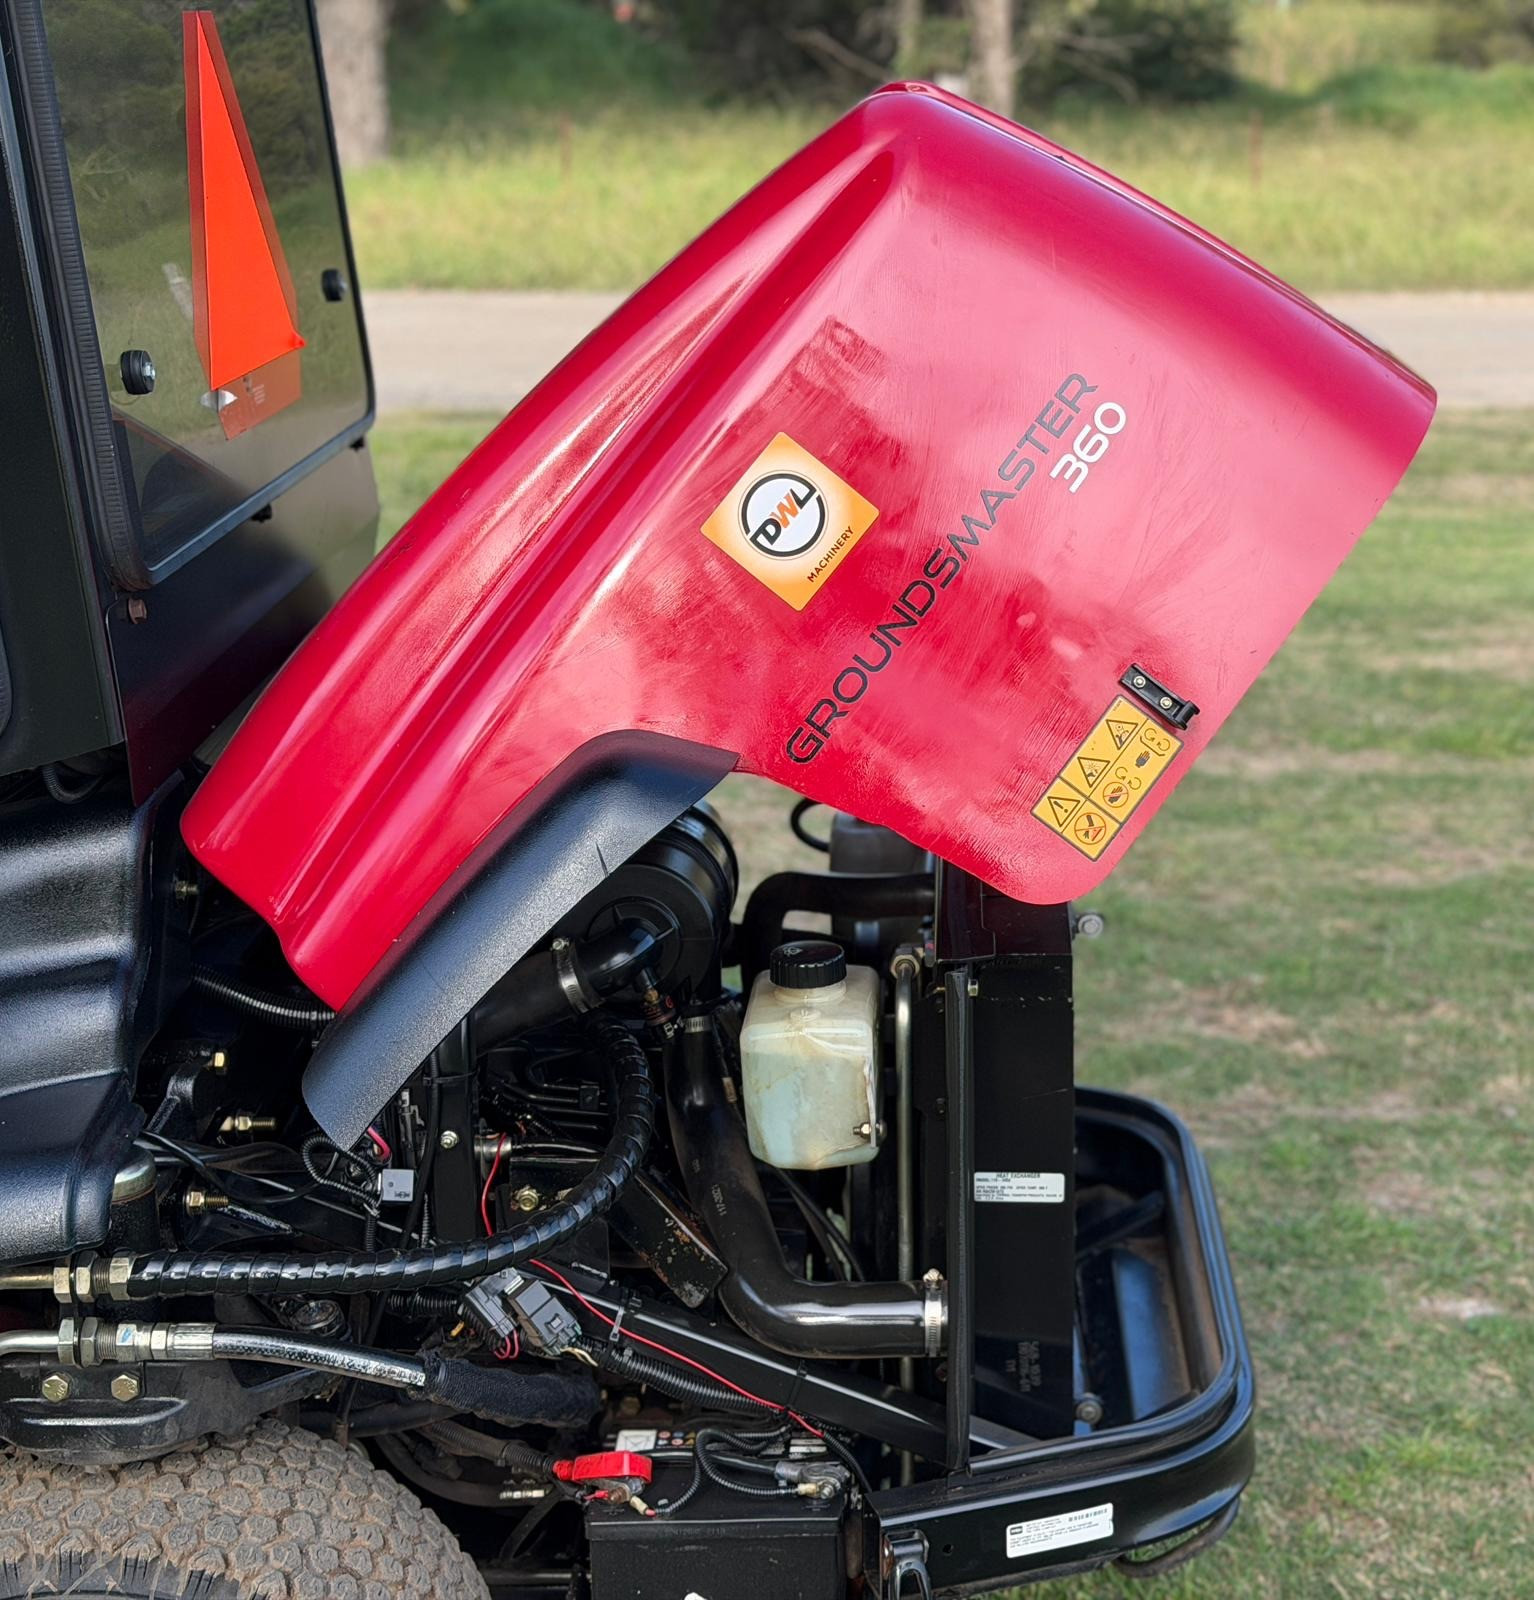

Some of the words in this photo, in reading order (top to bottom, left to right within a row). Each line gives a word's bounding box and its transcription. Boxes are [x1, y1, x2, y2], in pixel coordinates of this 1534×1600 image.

[1049, 402, 1126, 493] 360
[750, 487, 817, 546] DWL
[807, 526, 854, 582] MACHINERY
[787, 373, 1097, 764] GROUNDSMASTER
